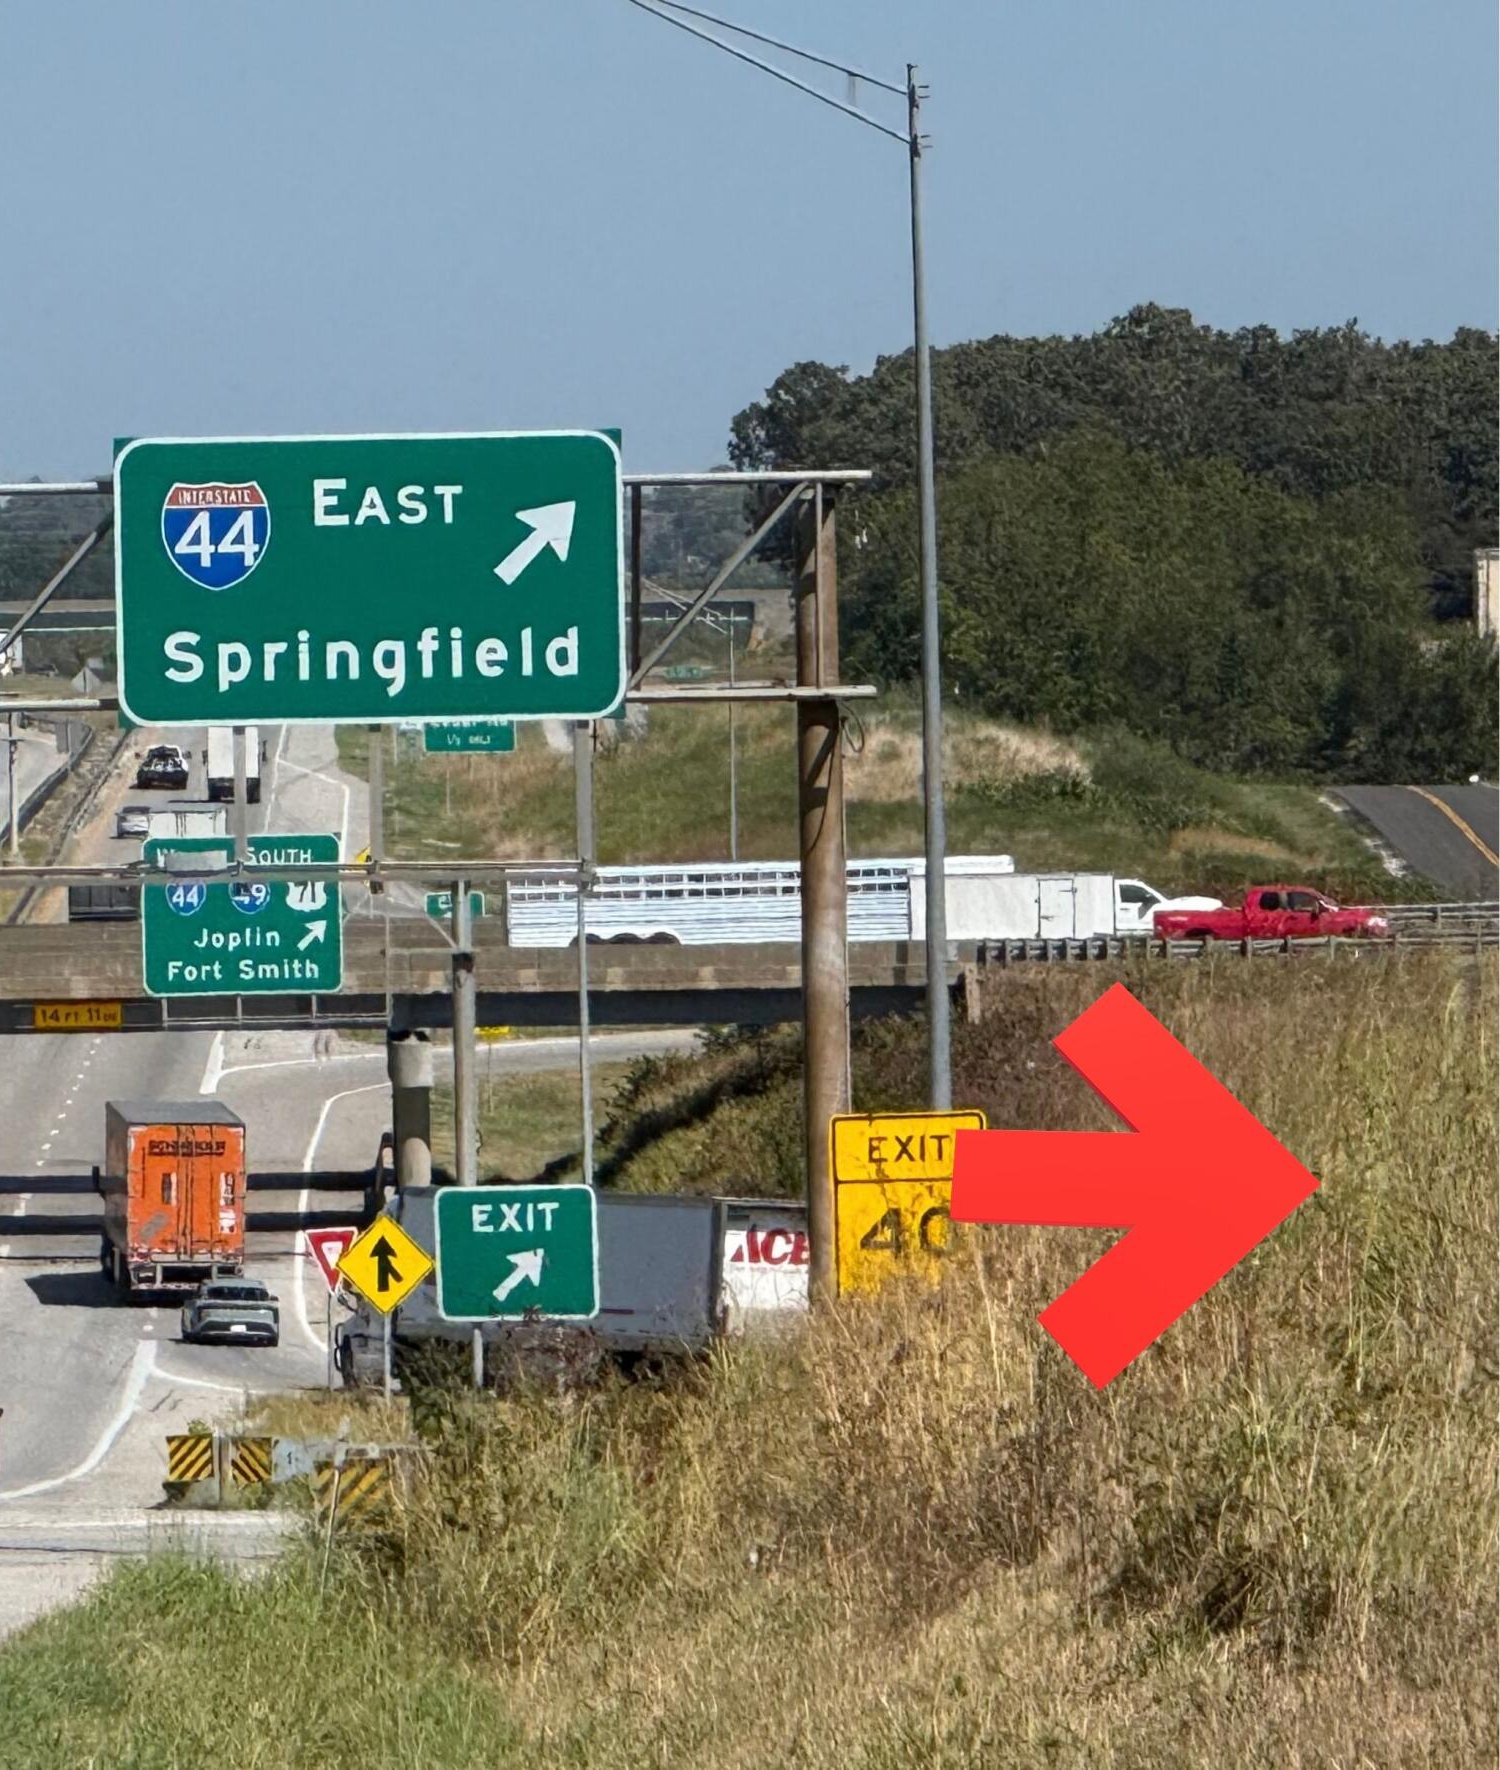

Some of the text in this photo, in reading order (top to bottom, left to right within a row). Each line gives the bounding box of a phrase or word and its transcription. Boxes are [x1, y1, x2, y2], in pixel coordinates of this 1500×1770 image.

[313, 478, 463, 525] EAST
[175, 510, 259, 568] 44
[163, 626, 579, 697] Springfield
[246, 847, 312, 864] SOUTH
[171, 884, 198, 907] 44
[294, 881, 317, 903] 71
[193, 927, 280, 951] Joplin
[168, 959, 319, 981] Fort Smith
[41, 1008, 60, 1022] 14
[87, 1008, 101, 1021] 11
[868, 1134, 950, 1163] EXIT
[472, 1202, 560, 1232] EXIT
